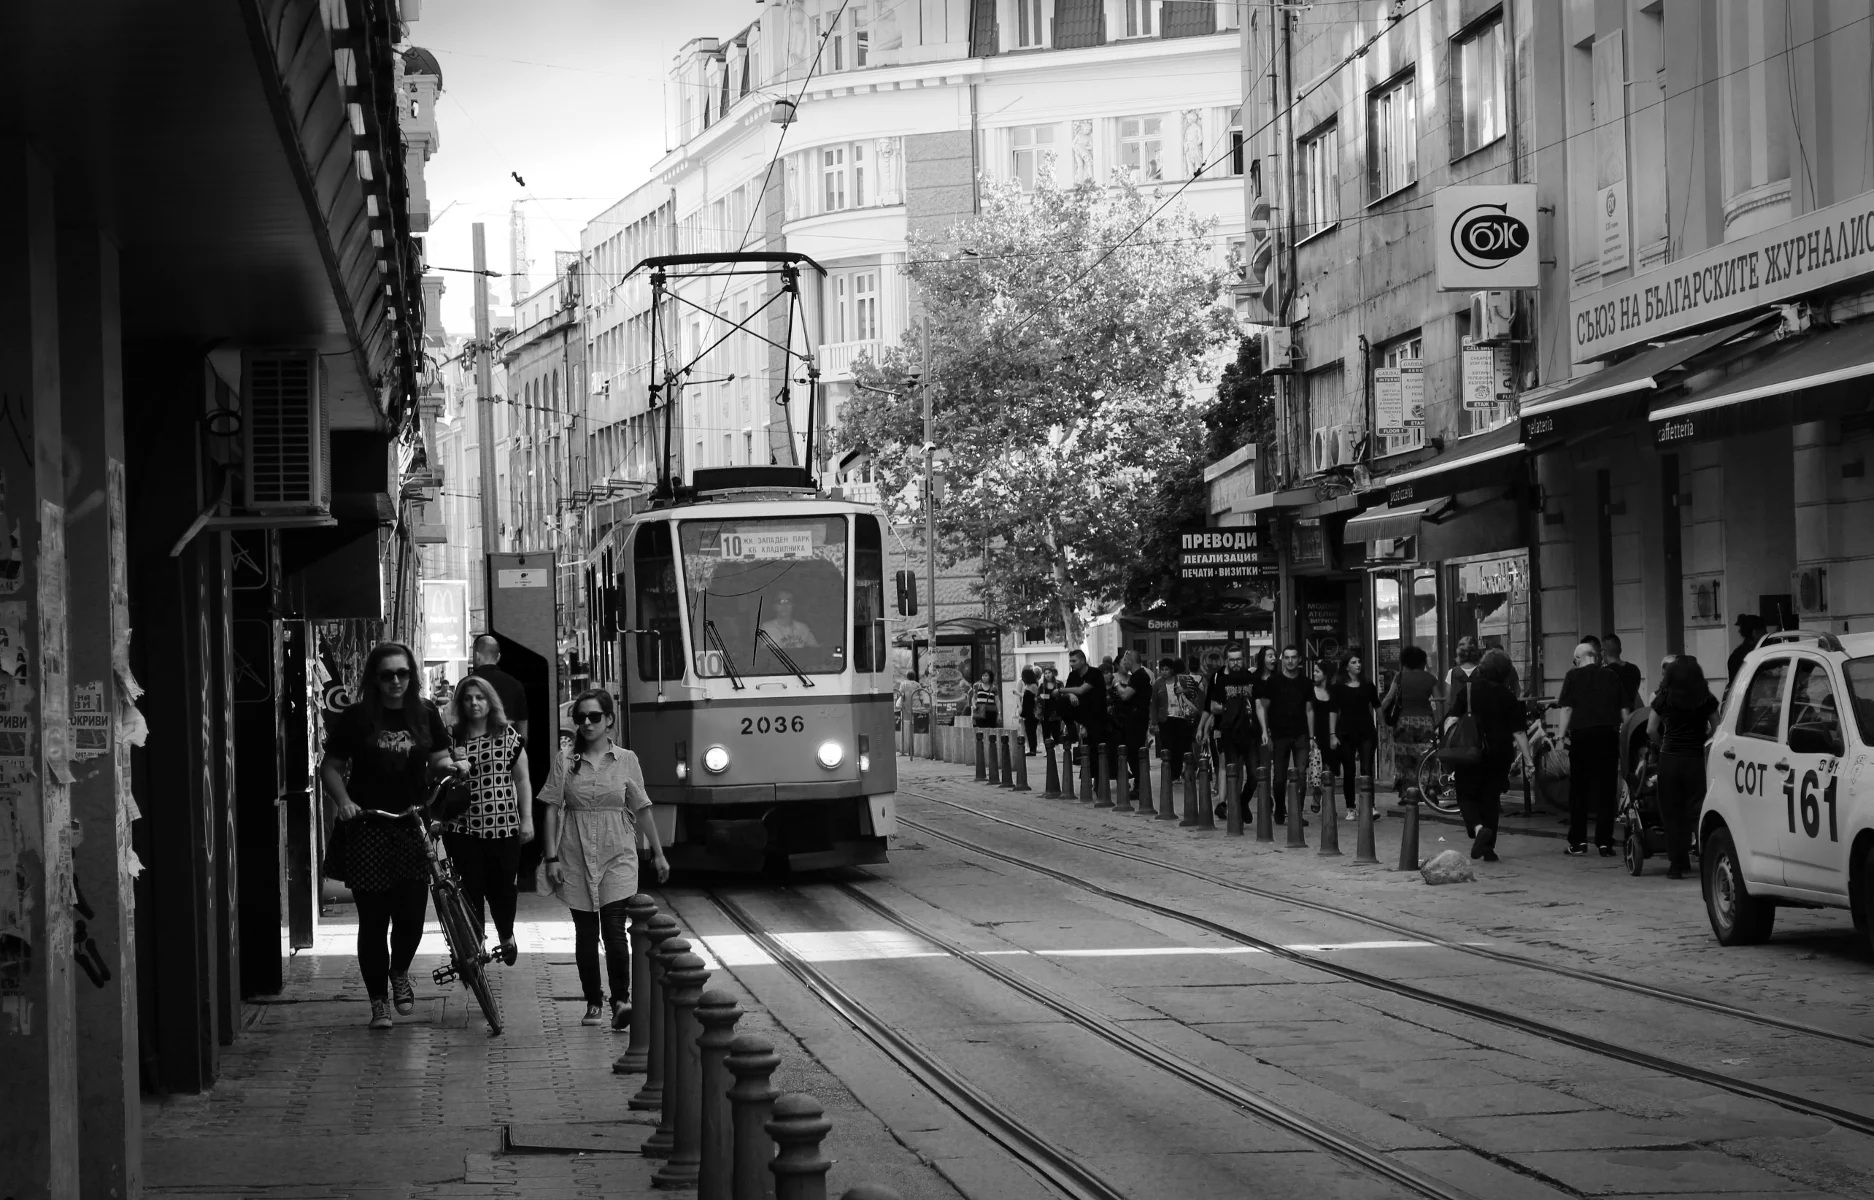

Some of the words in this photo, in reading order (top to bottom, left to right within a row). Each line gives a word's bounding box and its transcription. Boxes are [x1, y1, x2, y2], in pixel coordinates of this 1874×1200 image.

[1577, 301, 1616, 346] СЪЮЗ
[1620, 293, 1641, 332] НА
[1645, 251, 1759, 323] БЪЛГАРСКИТЕ
[1657, 418, 1694, 442] caffetteria
[723, 535, 742, 557] 10
[757, 536, 788, 545] ЗАПАДЕН
[792, 535, 810, 543] ПАРК
[761, 545, 805, 554] ХЛАДИЛНИКА
[1182, 532, 1258, 550] ПРЕВОДИ
[1183, 553, 1258, 564] ЛЕГАЛИЗАЦИЯ
[1182, 567, 1214, 578] ПЕЧАТИ
[1218, 566, 1258, 577] ВИЗИТКИ
[697, 653, 723, 677] 10
[741, 715, 804, 735] 2036
[1735, 760, 1768, 797] СОТ
[1783, 768, 1839, 843] 161
